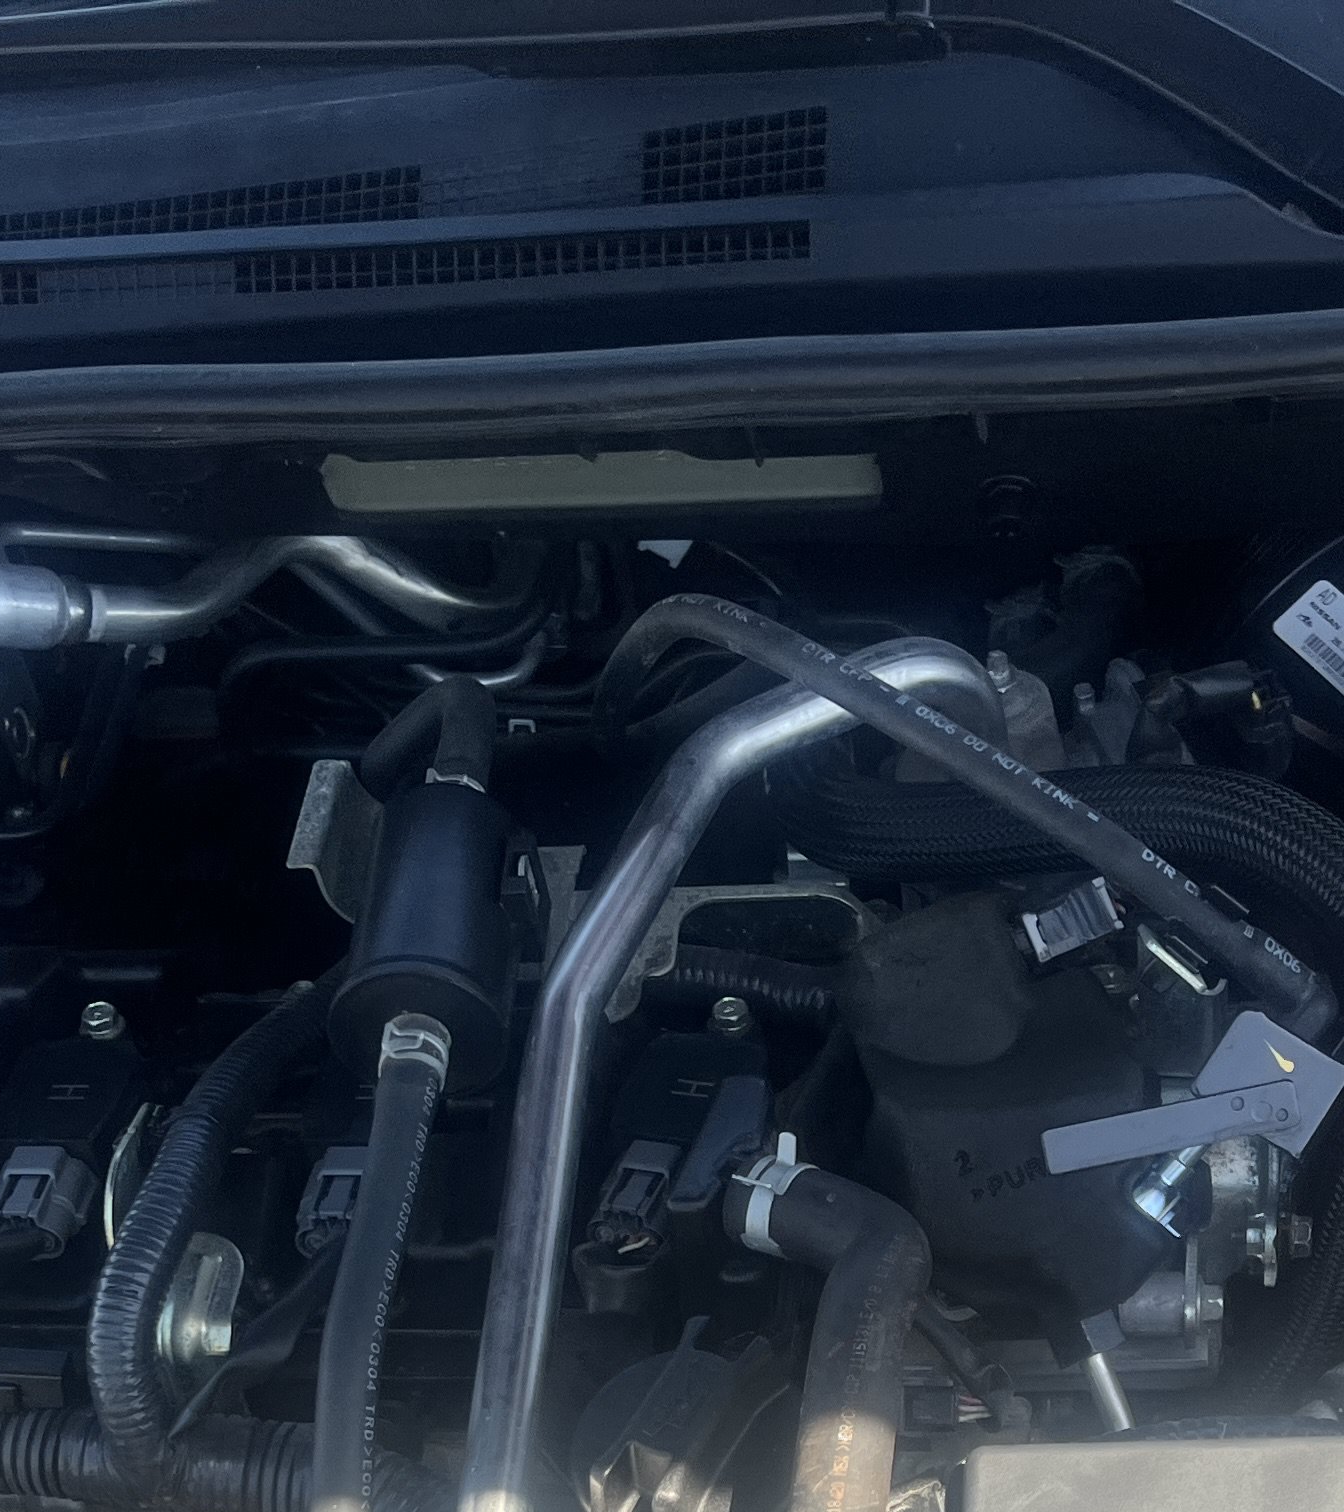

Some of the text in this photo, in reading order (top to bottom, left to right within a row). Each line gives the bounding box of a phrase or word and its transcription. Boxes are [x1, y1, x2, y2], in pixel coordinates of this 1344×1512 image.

[963, 735, 988, 751] DO
[992, 752, 1028, 775] NOT
[1031, 777, 1075, 809] KINK
